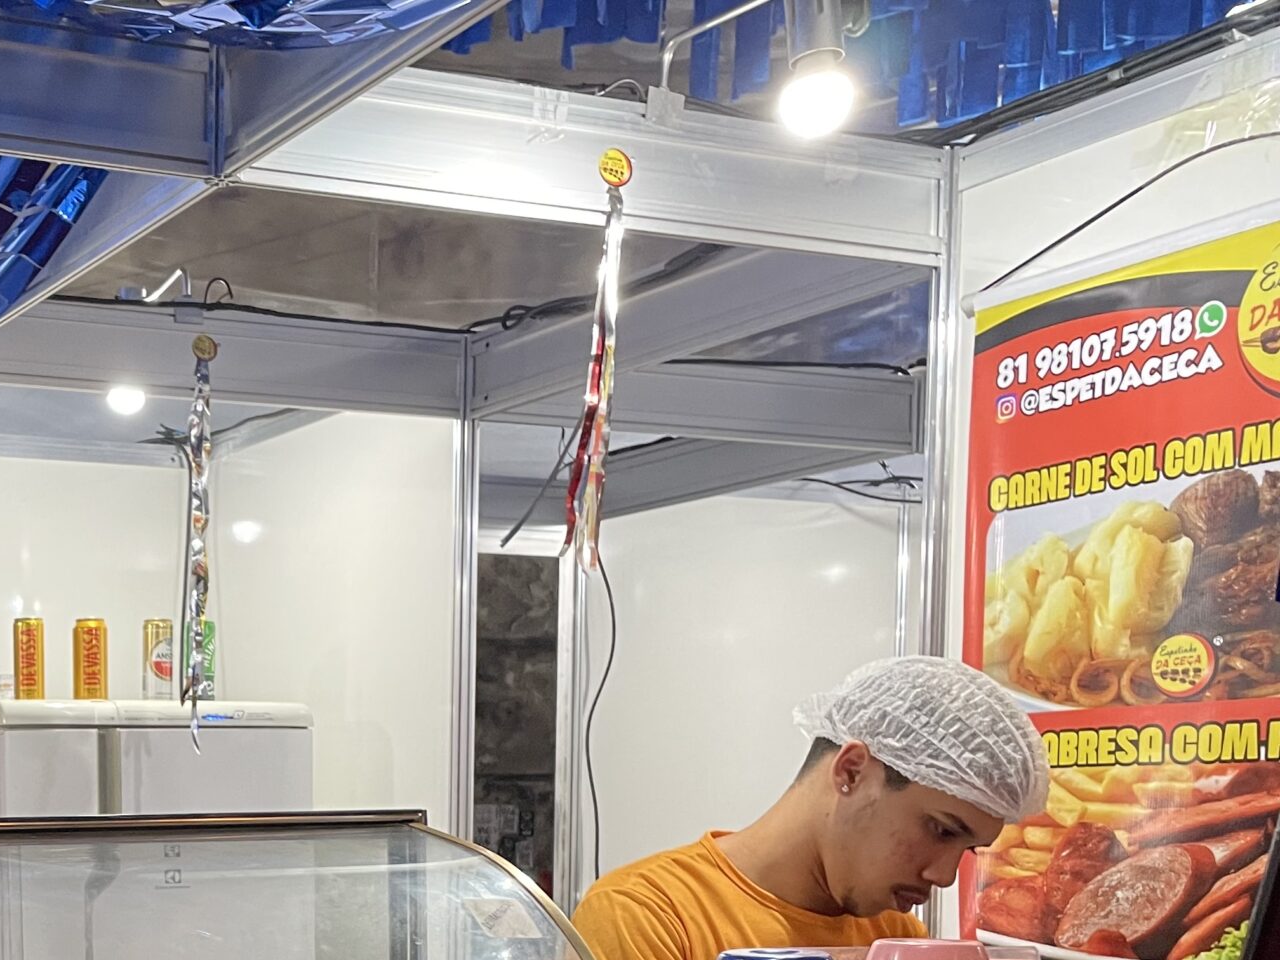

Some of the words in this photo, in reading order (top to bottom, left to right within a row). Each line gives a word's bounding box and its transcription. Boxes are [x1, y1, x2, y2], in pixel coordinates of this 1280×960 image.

[996, 353, 1028, 389] 81
[1035, 309, 1193, 379] 98107.5918
[1020, 343, 1224, 415] @ESPETDACECA
[989, 463, 1071, 512] CARNE
[1073, 455, 1108, 498] DE
[1109, 444, 1159, 488] SOL
[1163, 427, 1236, 480] COM
[20, 627, 37, 687] DEVASSA
[82, 627, 101, 686] DEVASSA
[1155, 659, 1169, 670] DA
[1173, 655, 1201, 667] CEÇA
[1160, 643, 1197, 659] Espetinho
[1171, 720, 1261, 764] COM
